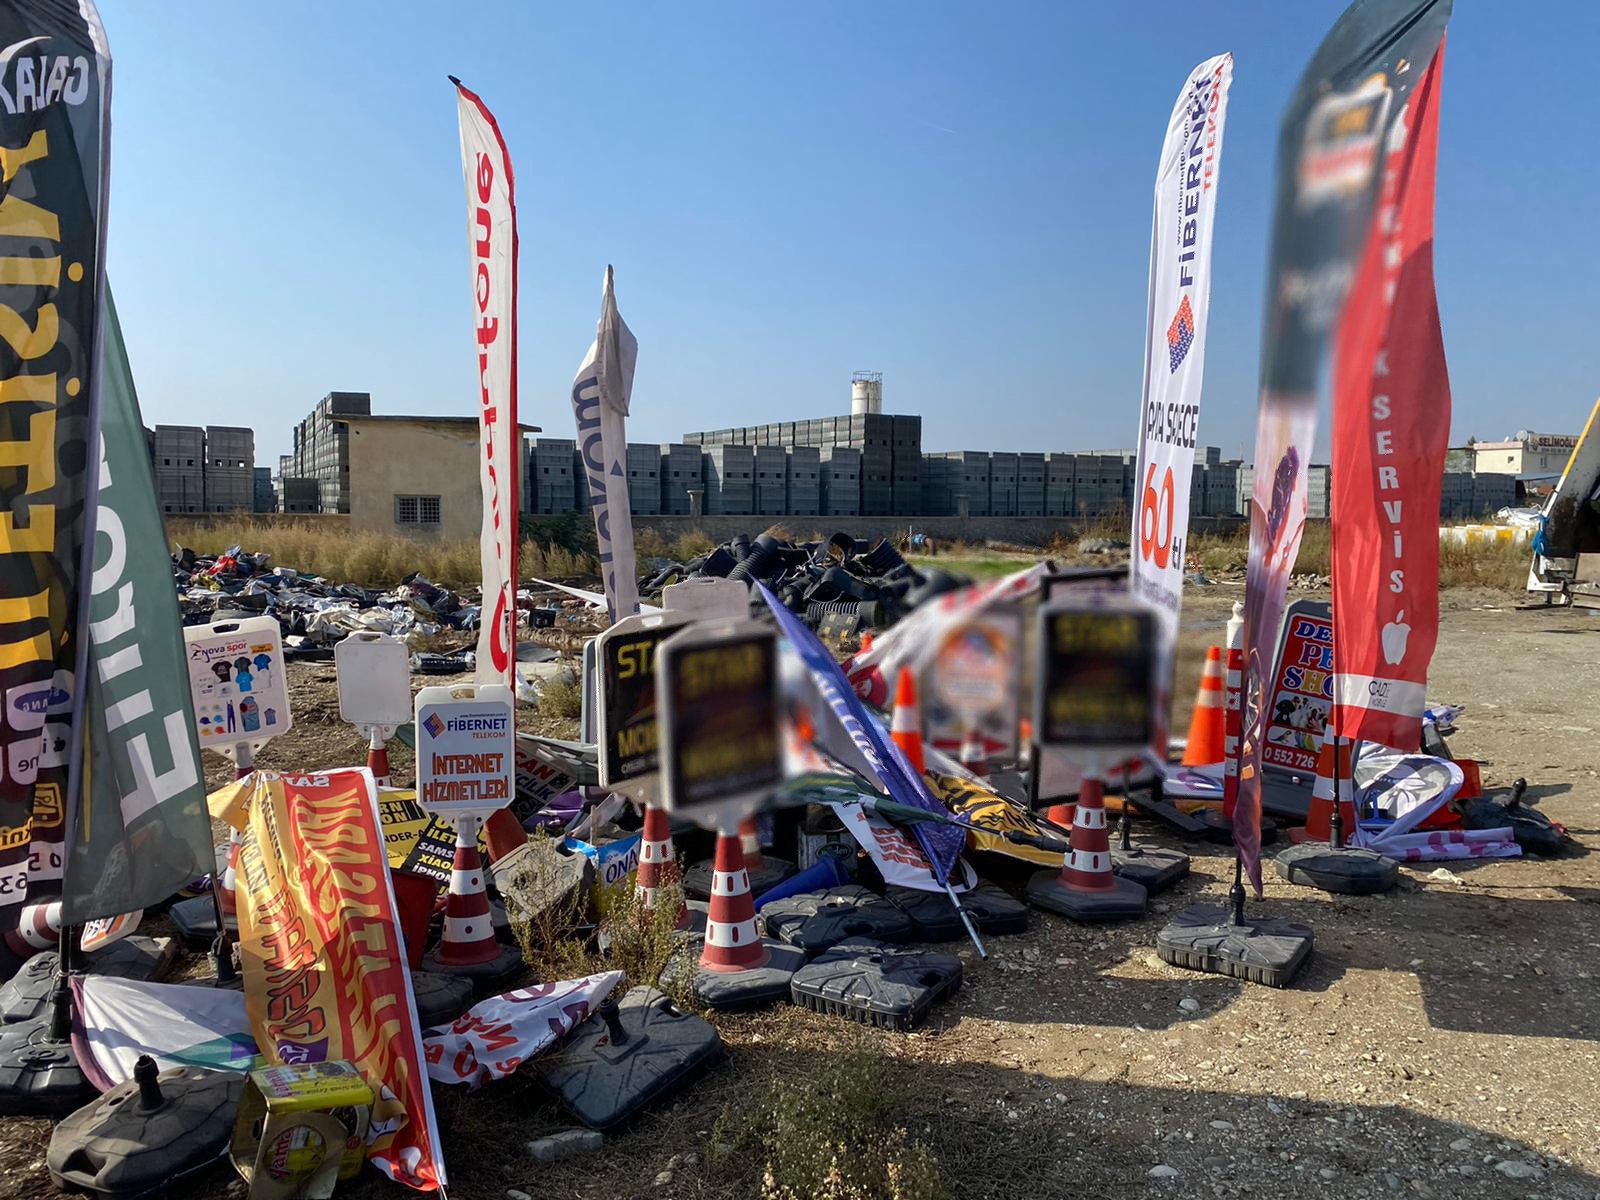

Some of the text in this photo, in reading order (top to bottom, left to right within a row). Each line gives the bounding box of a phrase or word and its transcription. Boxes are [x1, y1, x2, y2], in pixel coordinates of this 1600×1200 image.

[1371, 394, 1405, 594] SERVİS
[1140, 462, 1174, 570] 60
[1295, 621, 1333, 644] DE
[226, 642, 247, 654] spor
[447, 717, 508, 732] FİBERNET
[432, 752, 504, 775] İNTERNET
[1273, 748, 1294, 764] 552
[1295, 753, 1315, 769] 726
[423, 775, 509, 802] HİZMETLERİ
[418, 842, 455, 859] SAMS
